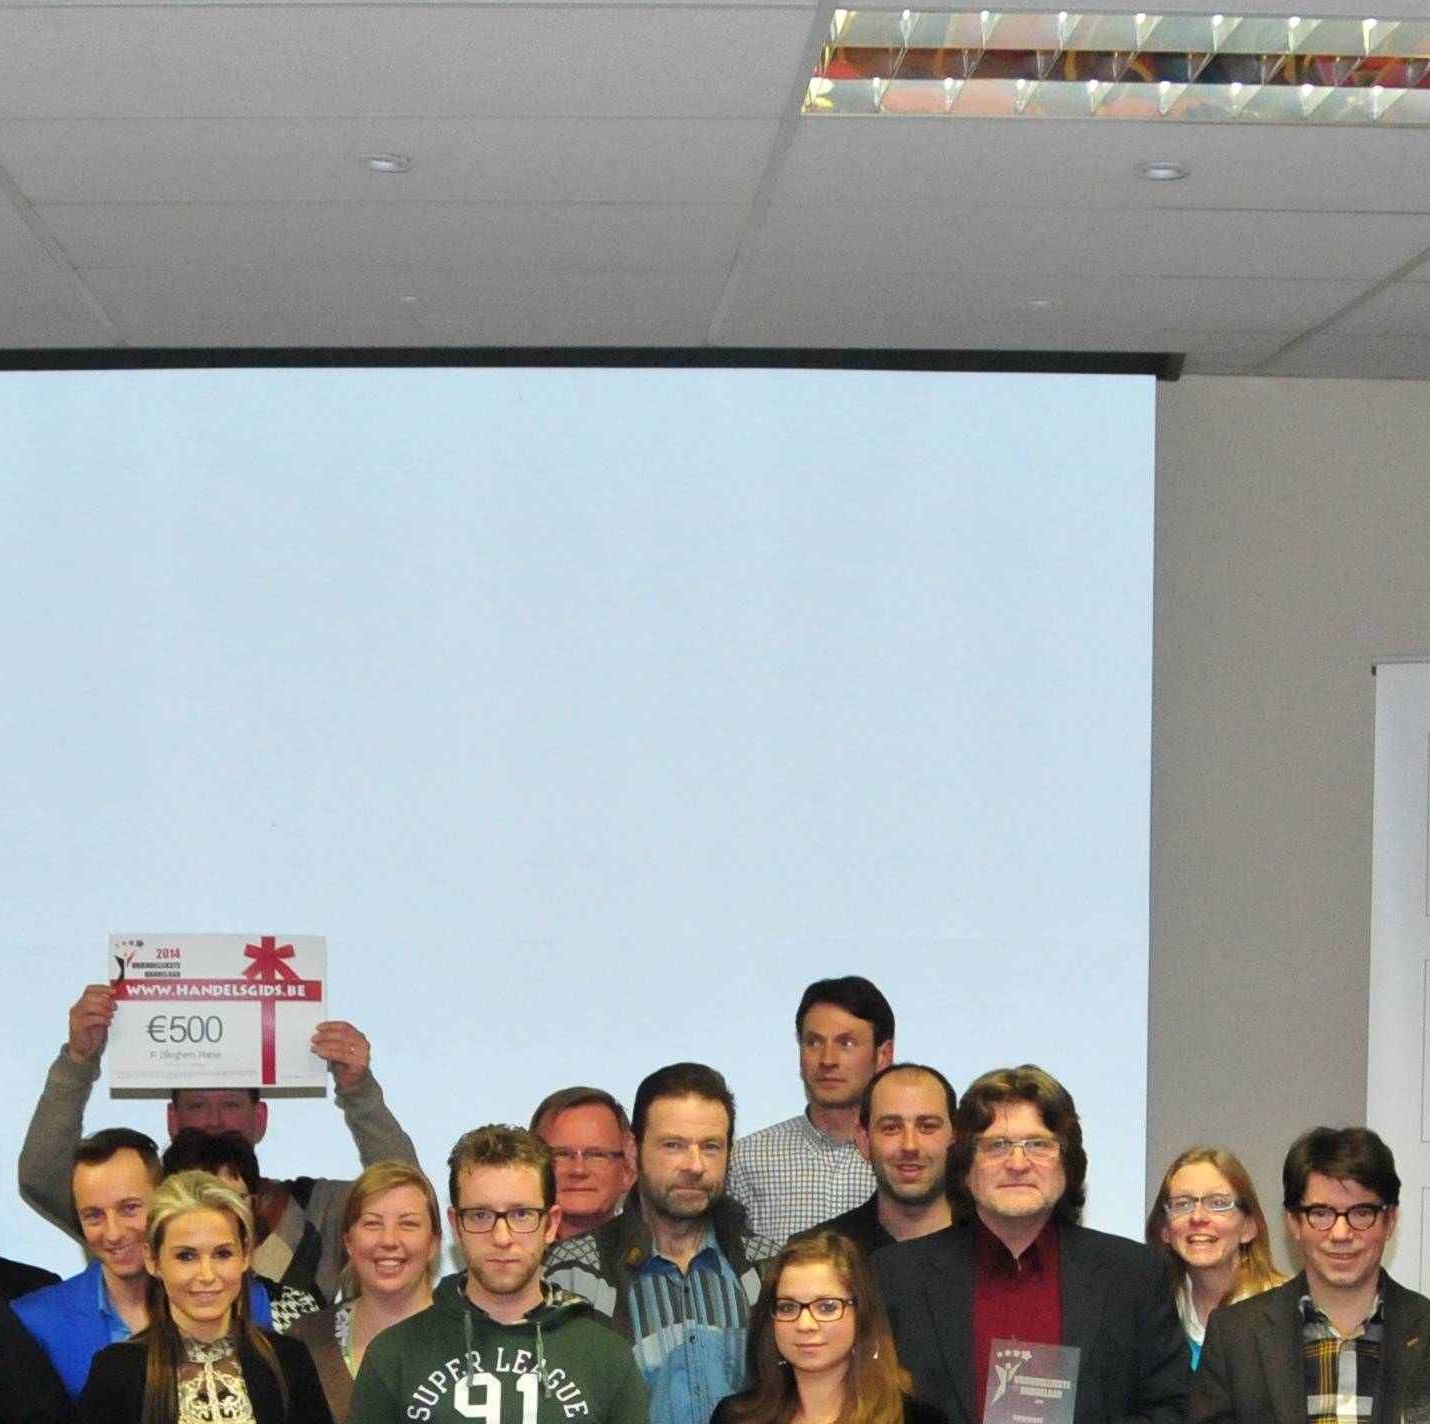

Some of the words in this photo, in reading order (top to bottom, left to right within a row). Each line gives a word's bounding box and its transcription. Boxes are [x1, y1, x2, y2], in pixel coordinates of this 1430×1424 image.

[156, 949, 181, 959] 2014
[126, 984, 306, 998] WWW.HANDELSGIDS.BE
[146, 1015, 224, 1043] €500
[407, 1350, 484, 1421] SUPER
[495, 1347, 589, 1419] LEAGUE
